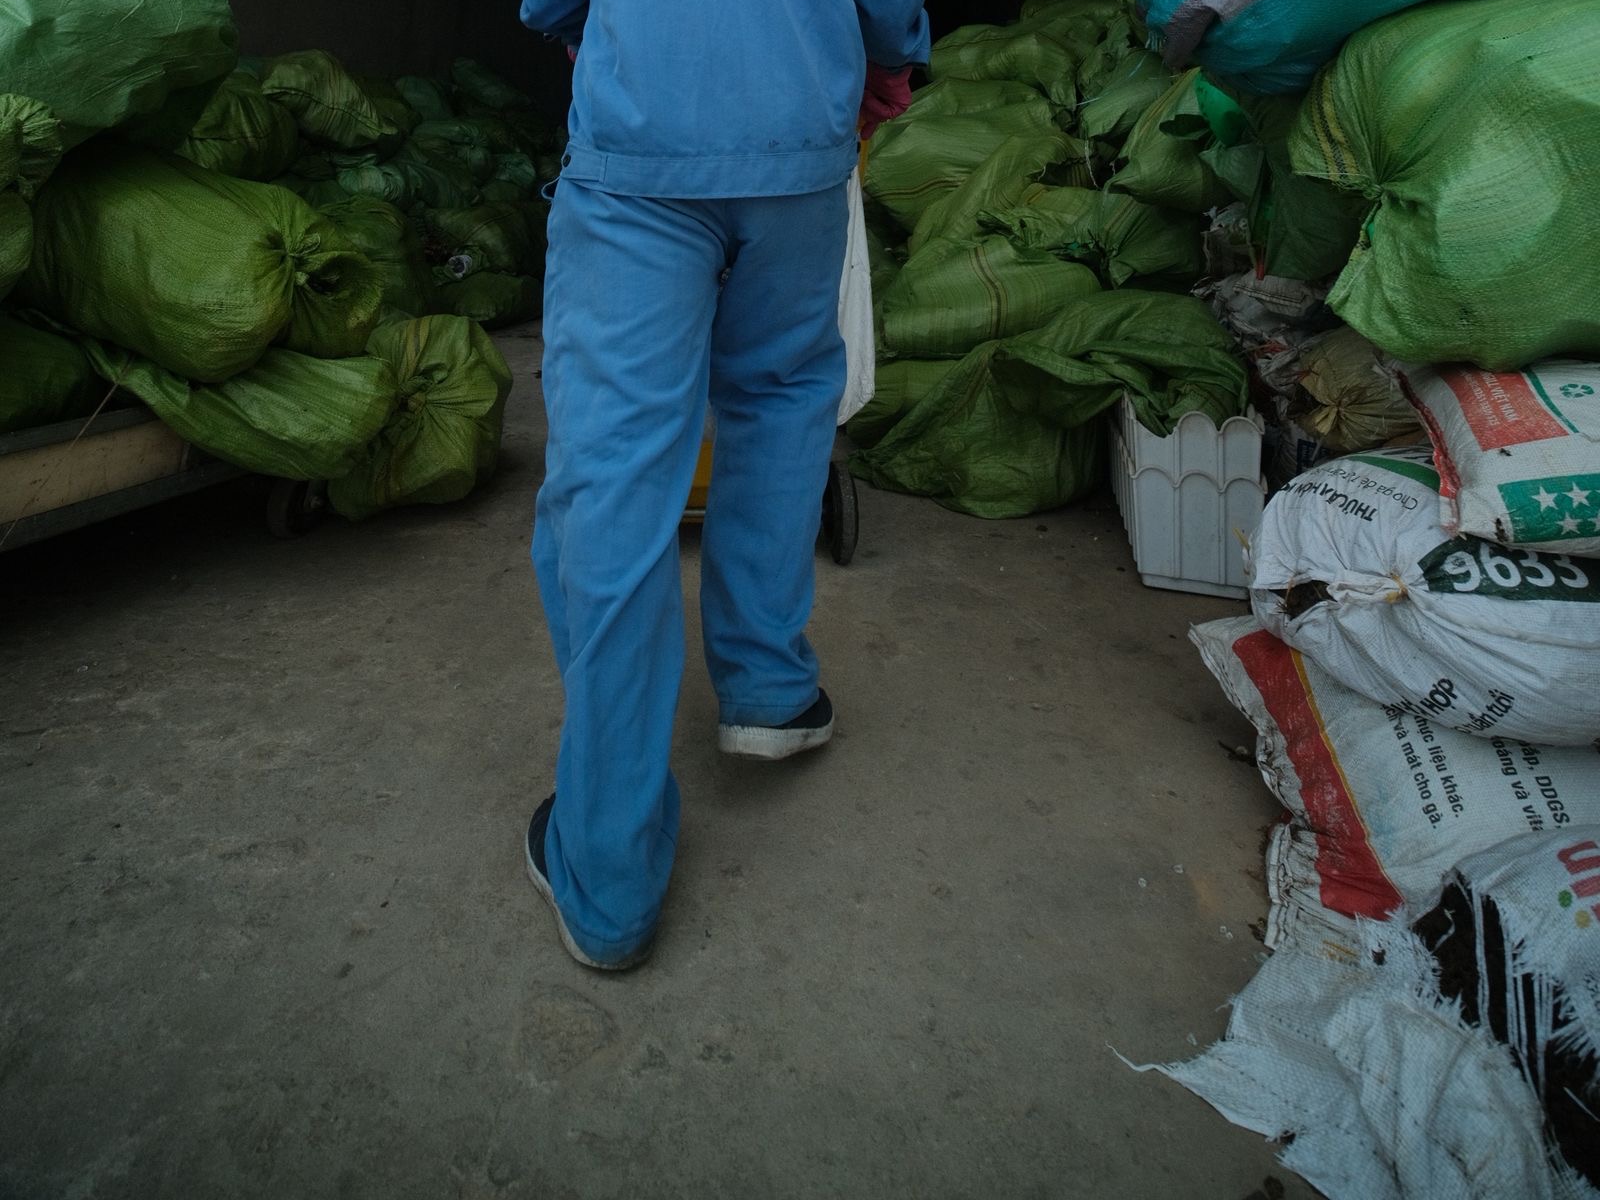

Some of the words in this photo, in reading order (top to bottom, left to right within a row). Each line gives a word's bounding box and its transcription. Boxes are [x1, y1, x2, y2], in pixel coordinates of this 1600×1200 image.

[1393, 492, 1418, 511] Cho
[1441, 542, 1590, 592] 9633
[1420, 678, 1458, 716] HỢP
[1486, 688, 1515, 719] tuổi
[1393, 718, 1408, 740] và
[1402, 741, 1422, 771] mát
[1491, 736, 1518, 776] oáng
[1511, 780, 1530, 800] và
[1414, 771, 1432, 800] cho
[1428, 745, 1448, 772] liệu
[1440, 775, 1464, 818] khác.
[1422, 802, 1443, 829] gà.
[1535, 775, 1570, 829] DDGS,
